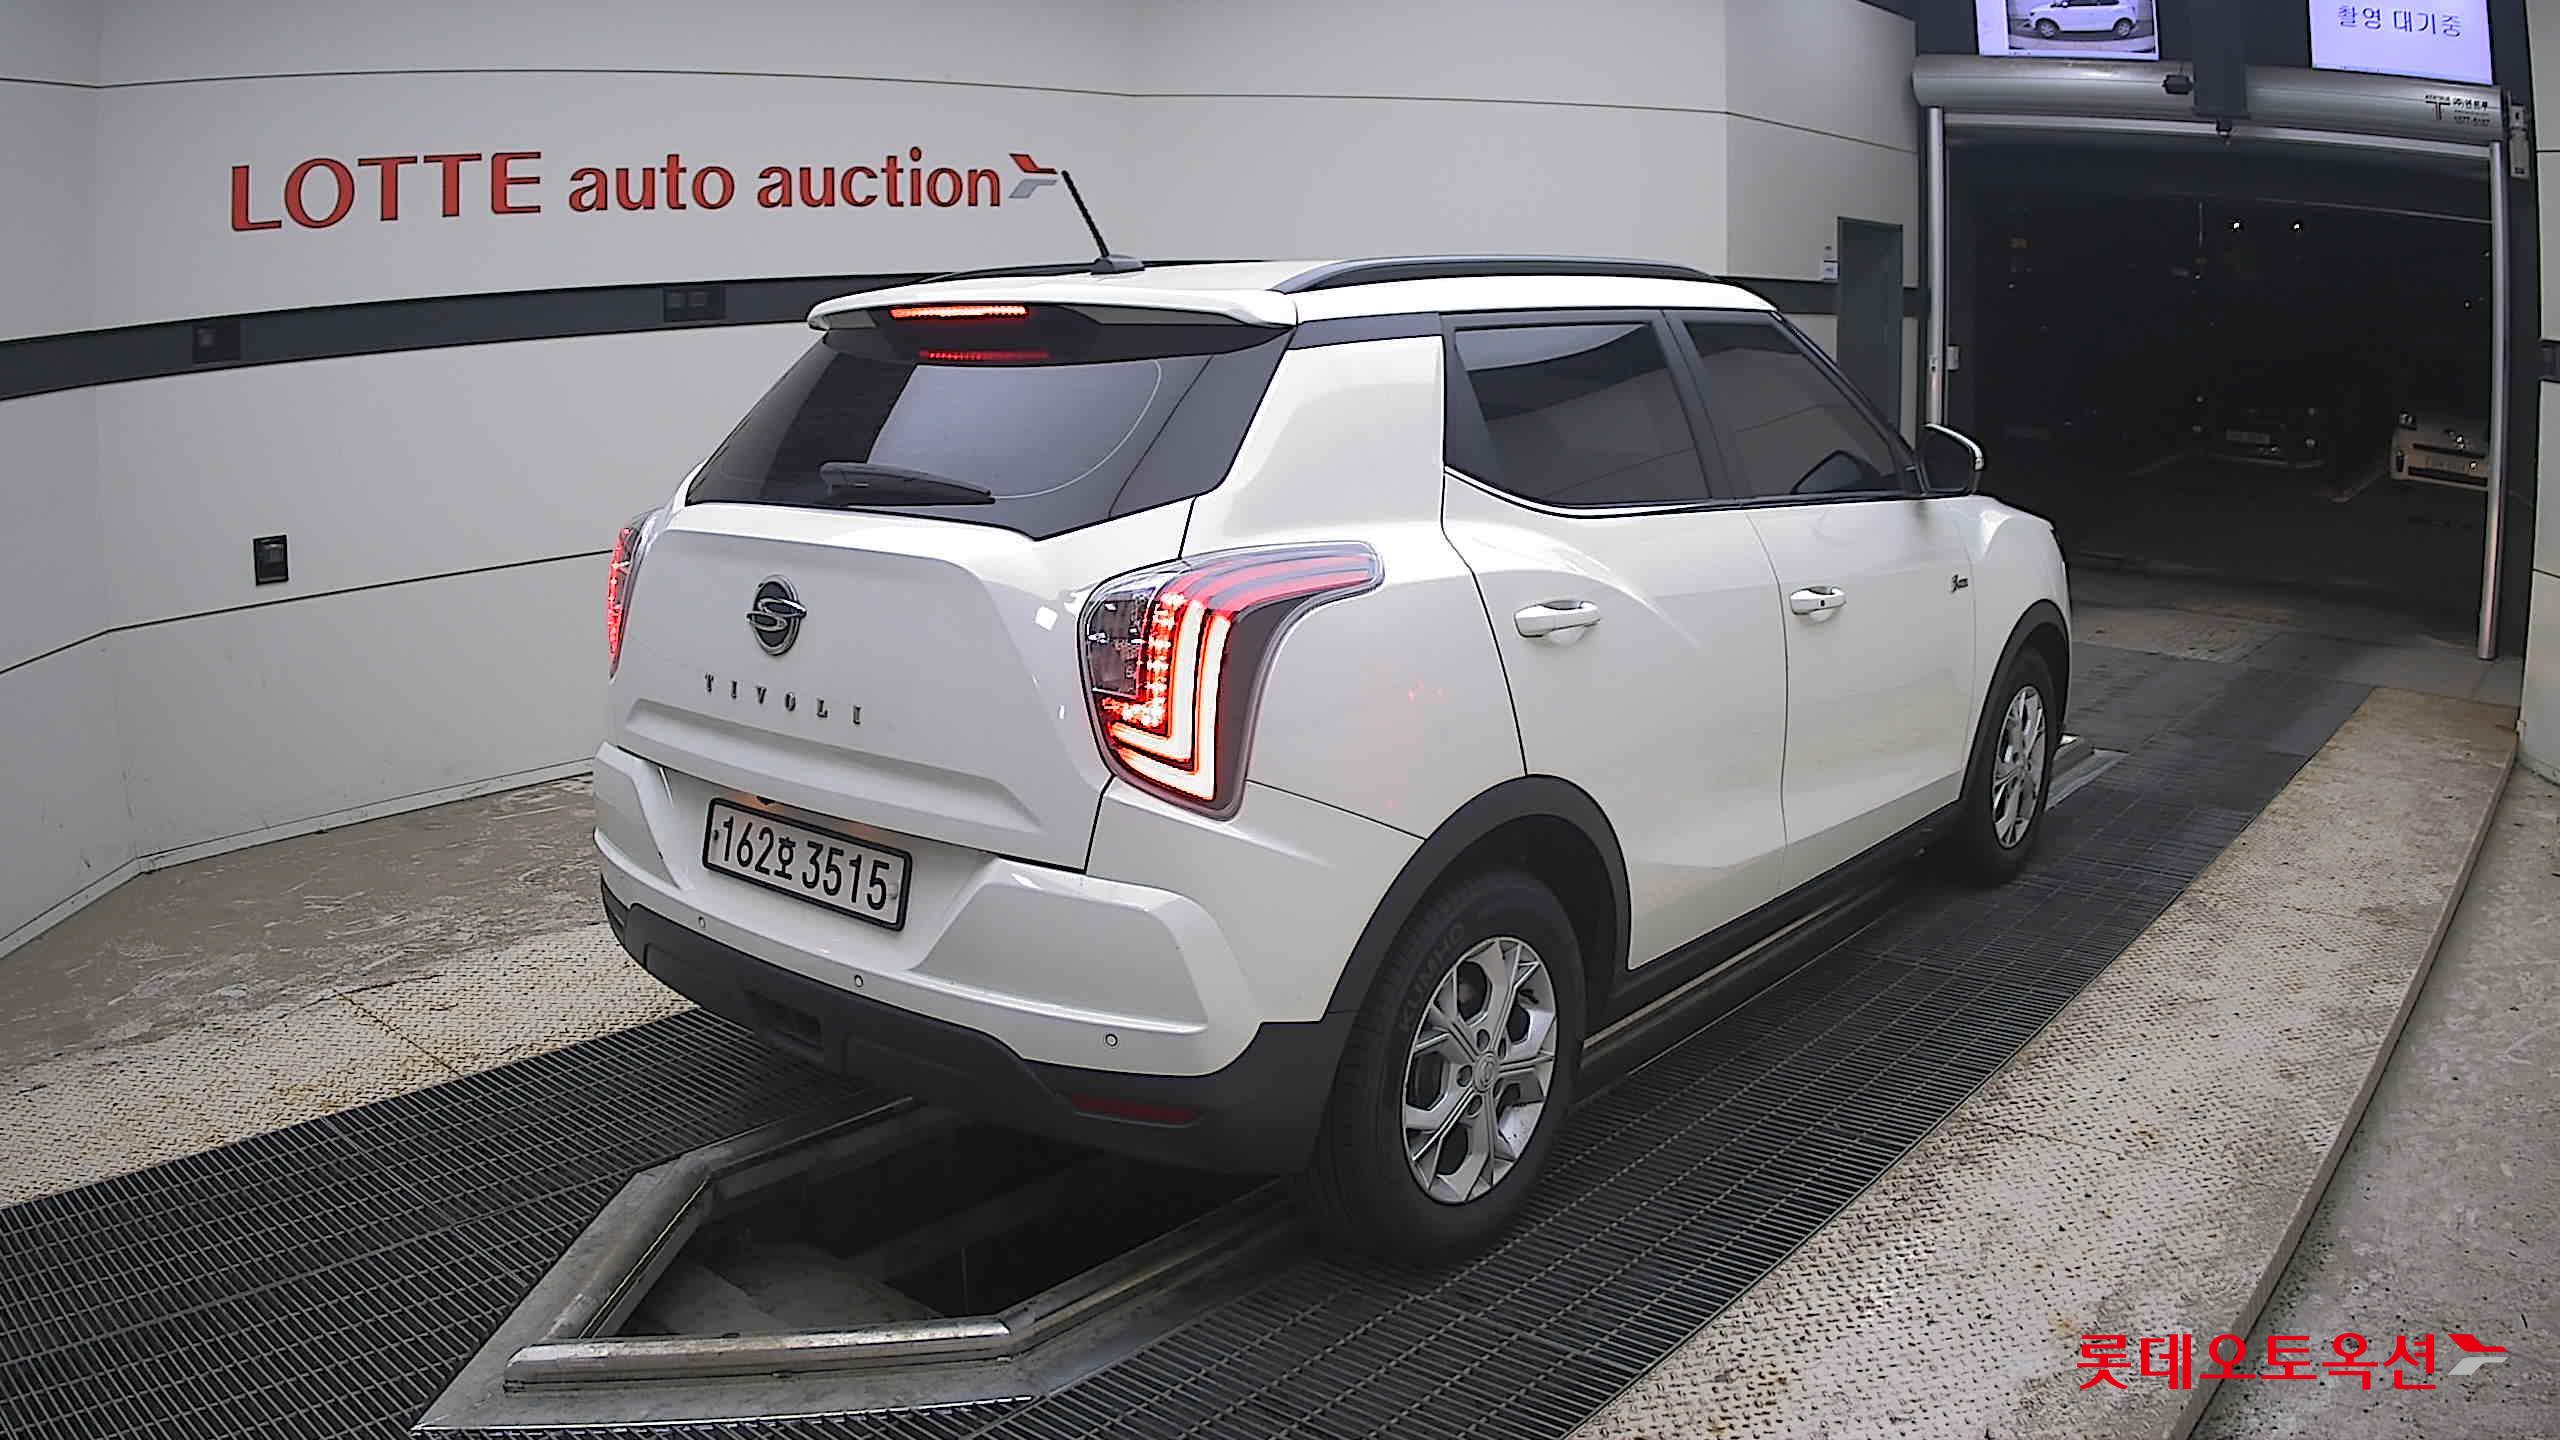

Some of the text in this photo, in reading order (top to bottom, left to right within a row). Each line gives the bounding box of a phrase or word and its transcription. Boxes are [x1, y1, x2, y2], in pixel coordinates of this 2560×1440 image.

[2337, 4, 2463, 38] 촬영 대기중
[231, 147, 1002, 232] LOTTE auto auction
[704, 672, 862, 726] TIVOLI
[721, 814, 891, 911] 162호 3515
